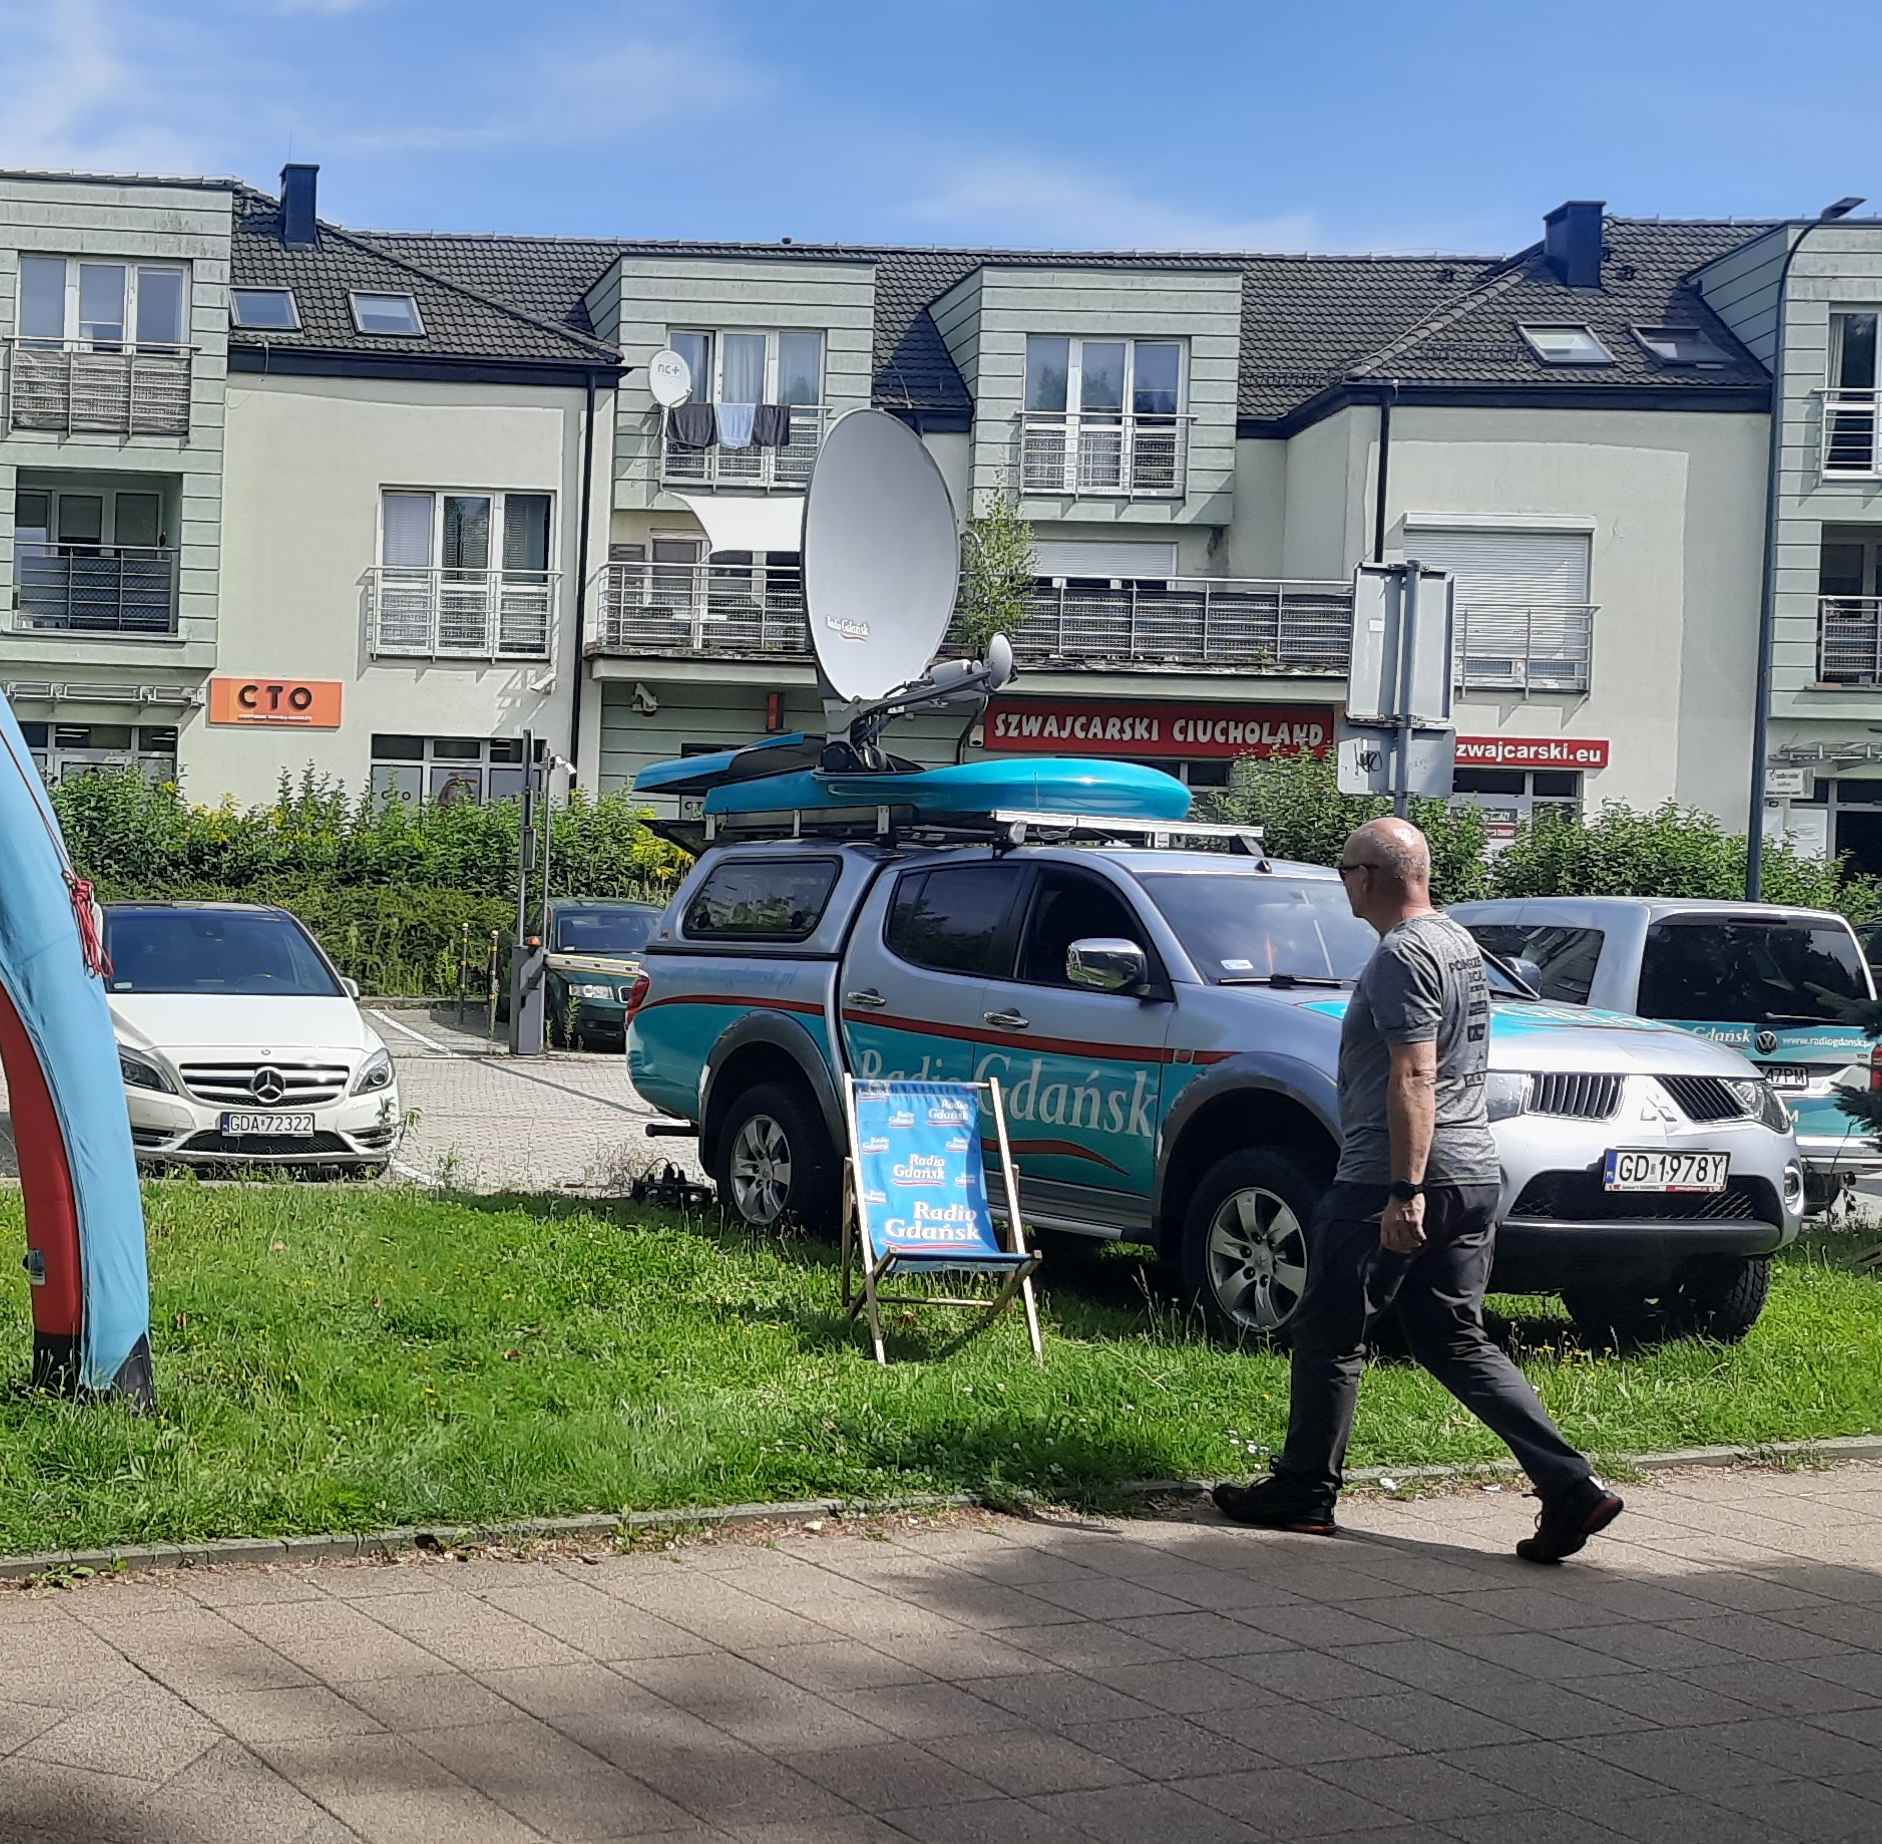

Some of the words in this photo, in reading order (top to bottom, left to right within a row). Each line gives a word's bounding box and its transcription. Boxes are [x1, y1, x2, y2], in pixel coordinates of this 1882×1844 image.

[238, 684, 313, 710] CTO
[994, 712, 1159, 741] SZWAJCARSKI
[1173, 718, 1324, 747] CIUCHOLAND
[1692, 1026, 1751, 1044] Gdańsk
[974, 1052, 1158, 1138] Gdańsk
[230, 1115, 260, 1132] GDA
[265, 1116, 311, 1132] 72322
[910, 1154, 945, 1166] Radio
[1619, 1155, 1650, 1182] GD
[1659, 1155, 1723, 1183] 1978Y
[893, 1164, 945, 1180] Gdańsk
[914, 1201, 977, 1221] Radio
[885, 1218, 981, 1241] Gdańsk
